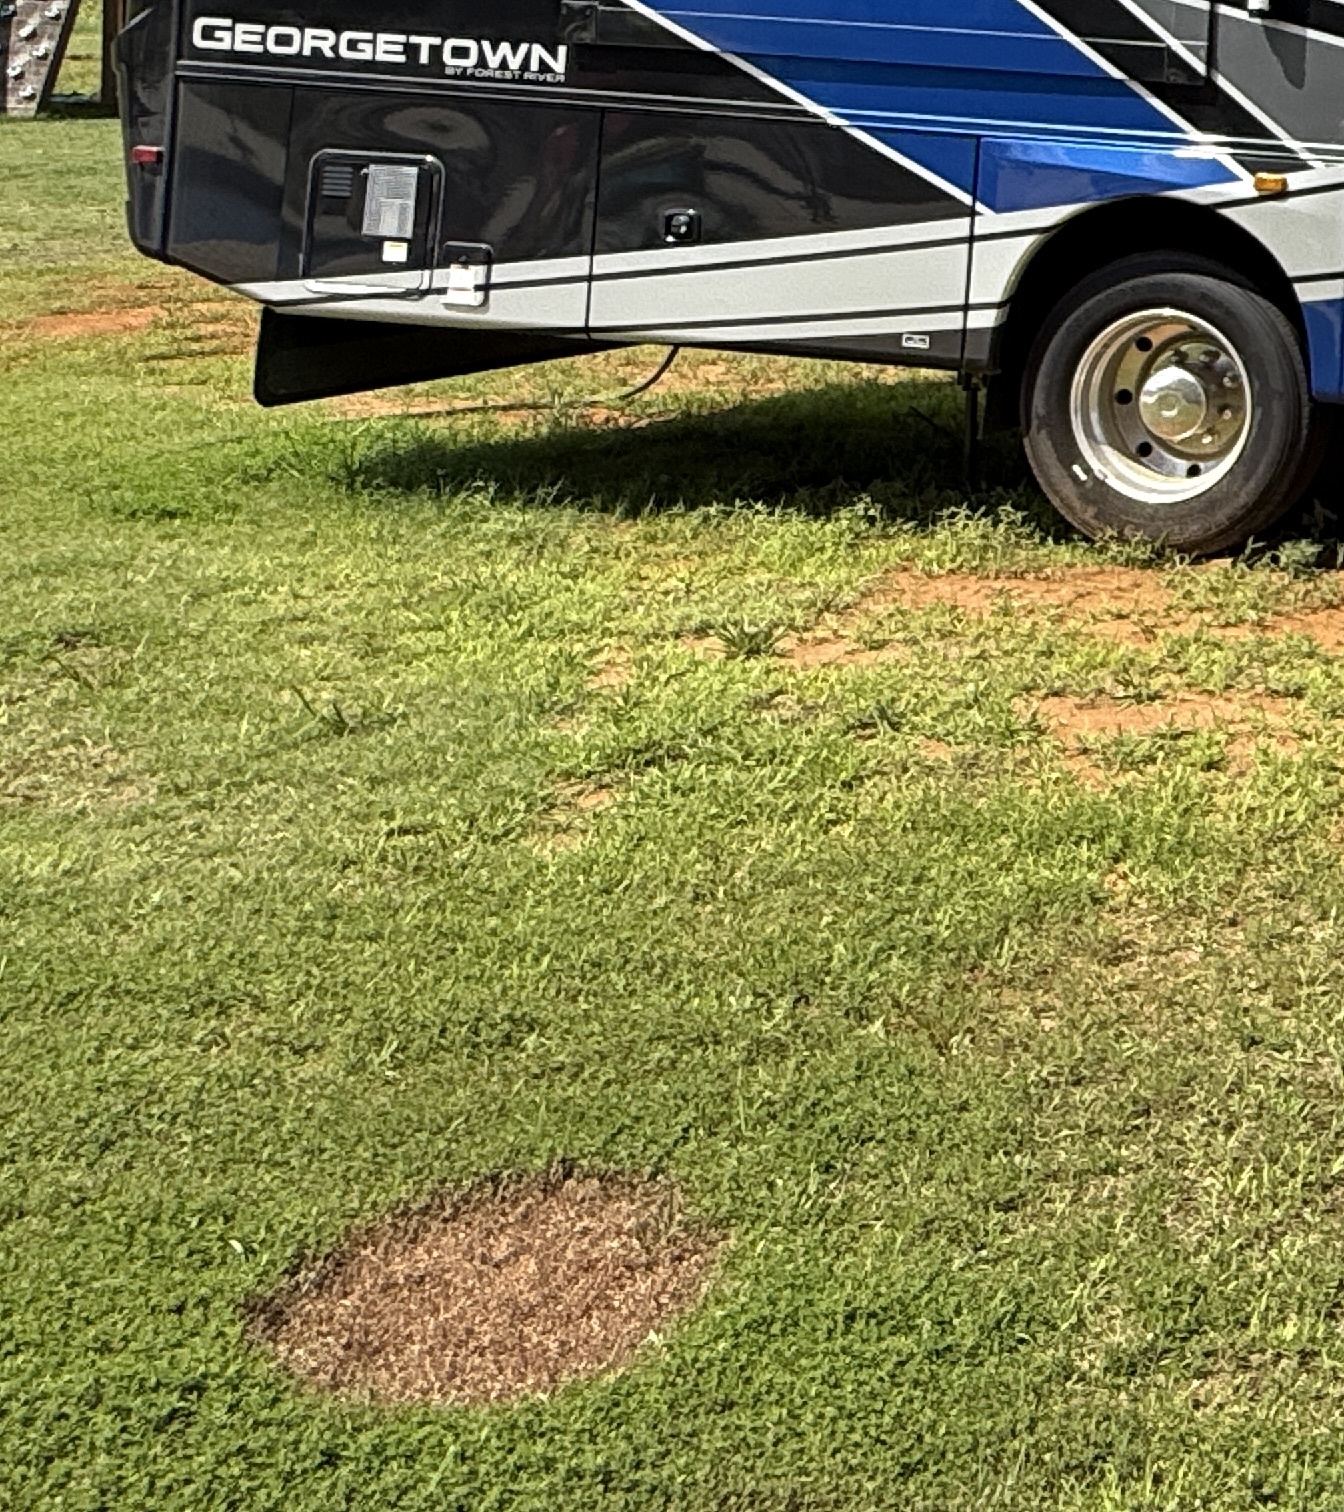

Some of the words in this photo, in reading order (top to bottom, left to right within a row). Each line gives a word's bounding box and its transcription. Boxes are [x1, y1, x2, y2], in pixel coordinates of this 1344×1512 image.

[192, 16, 568, 74] GEORGETOWN
[444, 66, 463, 76] BY
[466, 67, 521, 80] FOREST
[523, 71, 566, 83] RIVER
